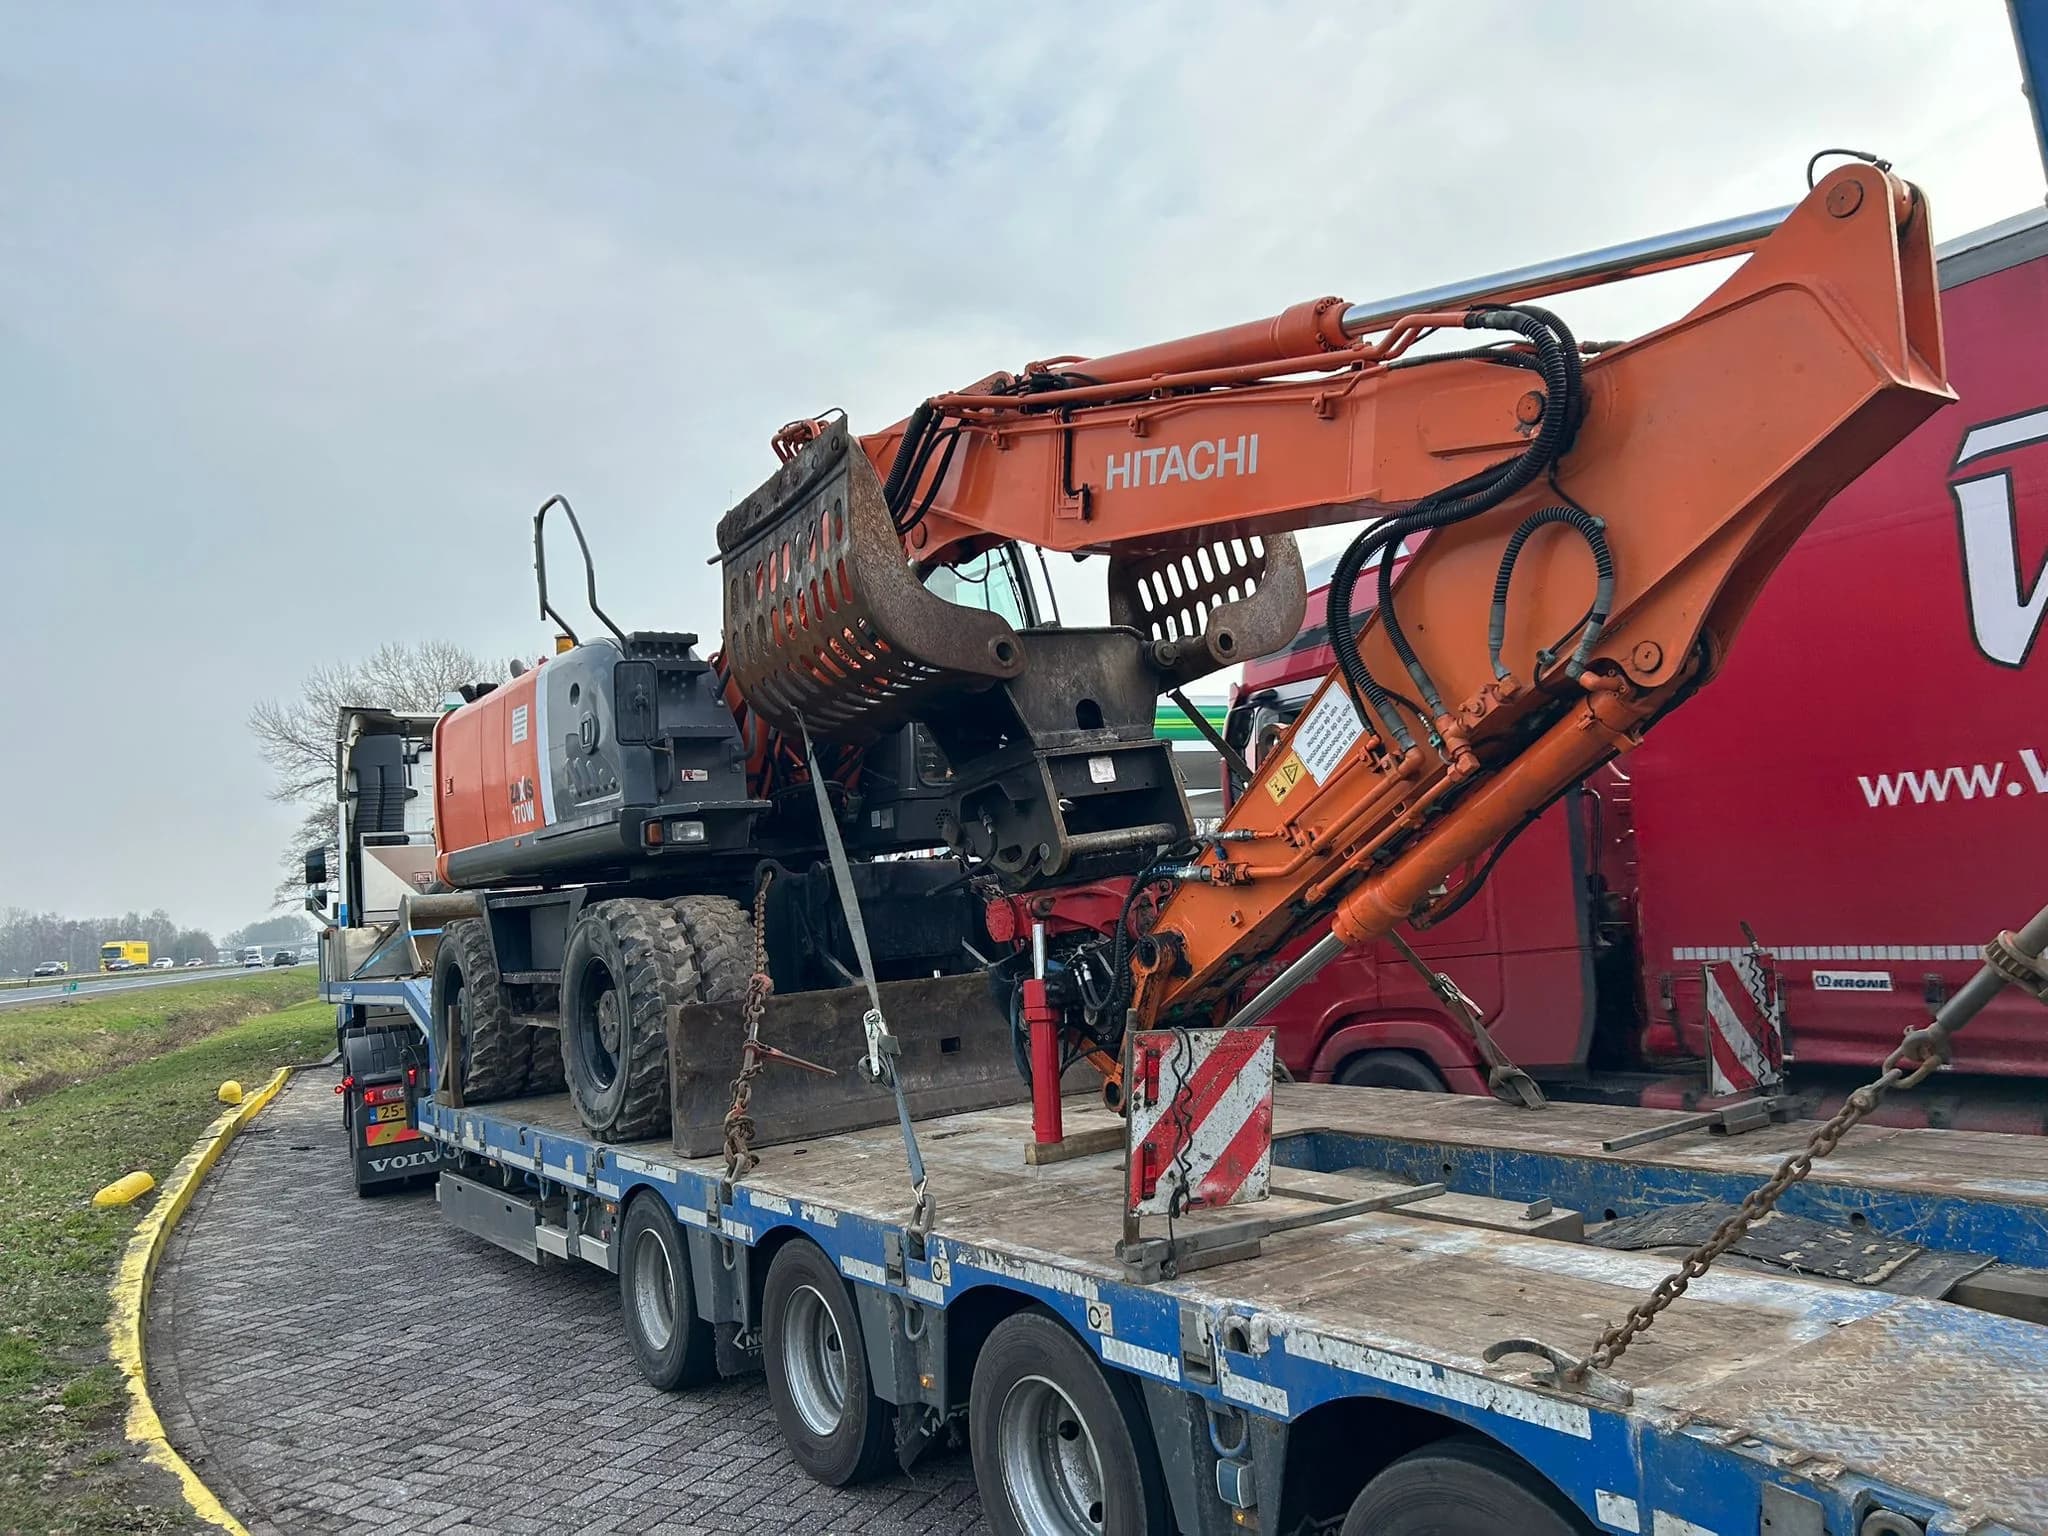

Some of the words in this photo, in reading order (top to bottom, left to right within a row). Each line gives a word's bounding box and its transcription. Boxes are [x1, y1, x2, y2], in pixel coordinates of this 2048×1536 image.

[1106, 434, 1258, 490] HITACHI
[510, 776, 534, 803] ZAXIS
[511, 800, 535, 824] 170W
[1833, 978, 1889, 988] KRONE
